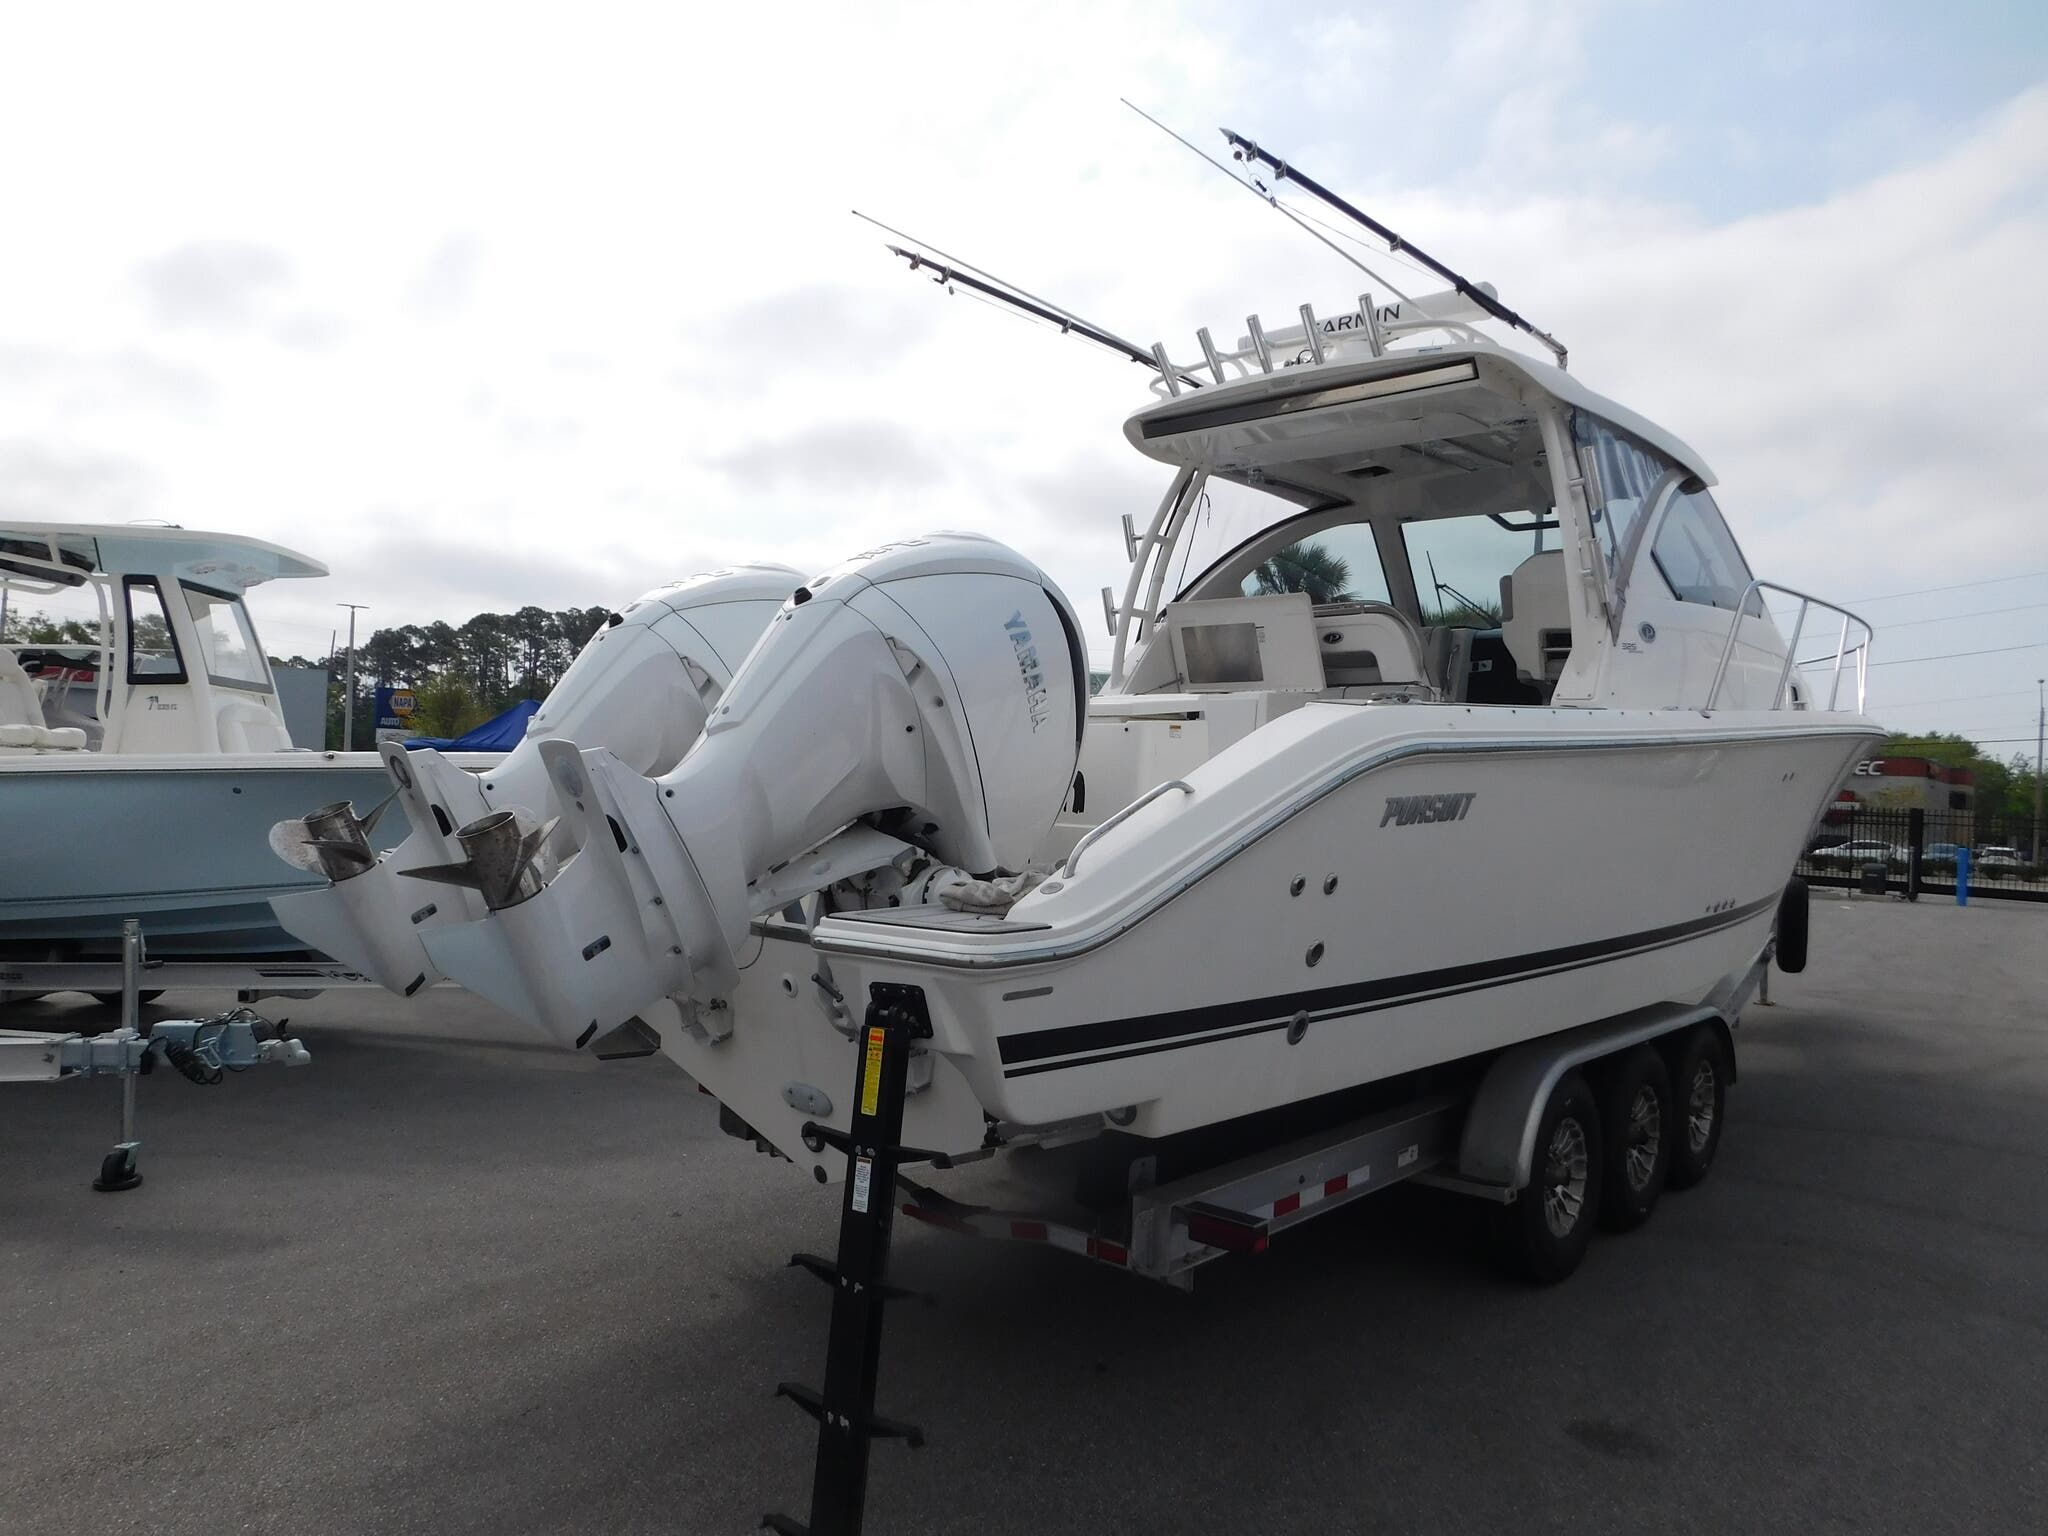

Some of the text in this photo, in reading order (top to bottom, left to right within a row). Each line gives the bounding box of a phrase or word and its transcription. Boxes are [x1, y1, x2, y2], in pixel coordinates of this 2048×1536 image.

[1316, 304, 1400, 333] ARMIN
[1004, 609, 1050, 734] YAMAHA
[380, 717, 400, 726] AUTO
[1379, 792, 1477, 828] PURSUIT
